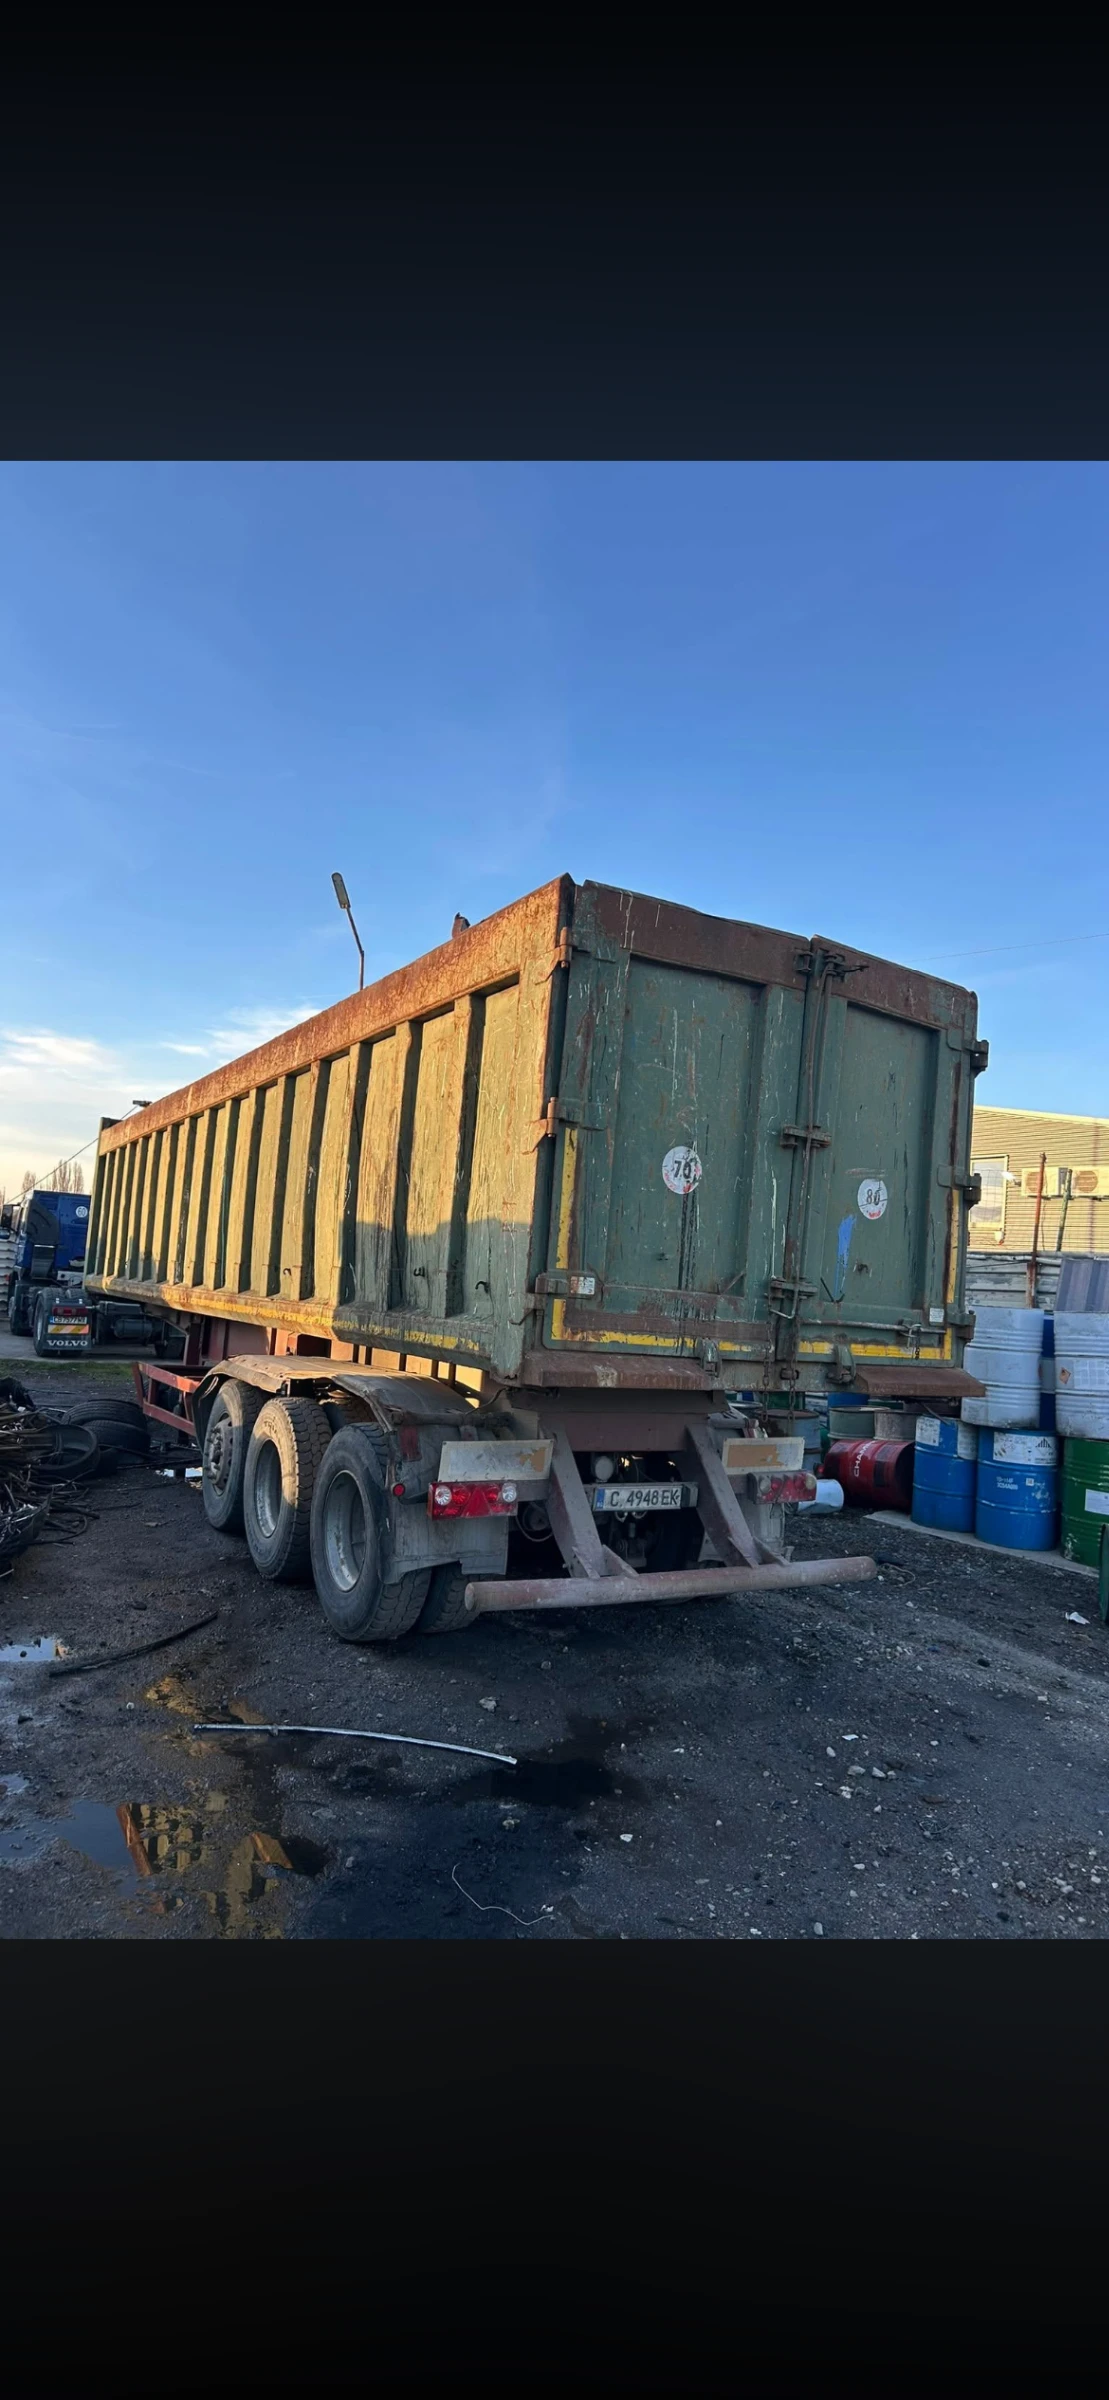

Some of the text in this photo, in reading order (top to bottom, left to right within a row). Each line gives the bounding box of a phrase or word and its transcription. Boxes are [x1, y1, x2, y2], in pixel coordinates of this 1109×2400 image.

[674, 1160, 692, 1180] 70
[866, 1188, 881, 1206] 80
[47, 1339, 88, 1347] VOLVO
